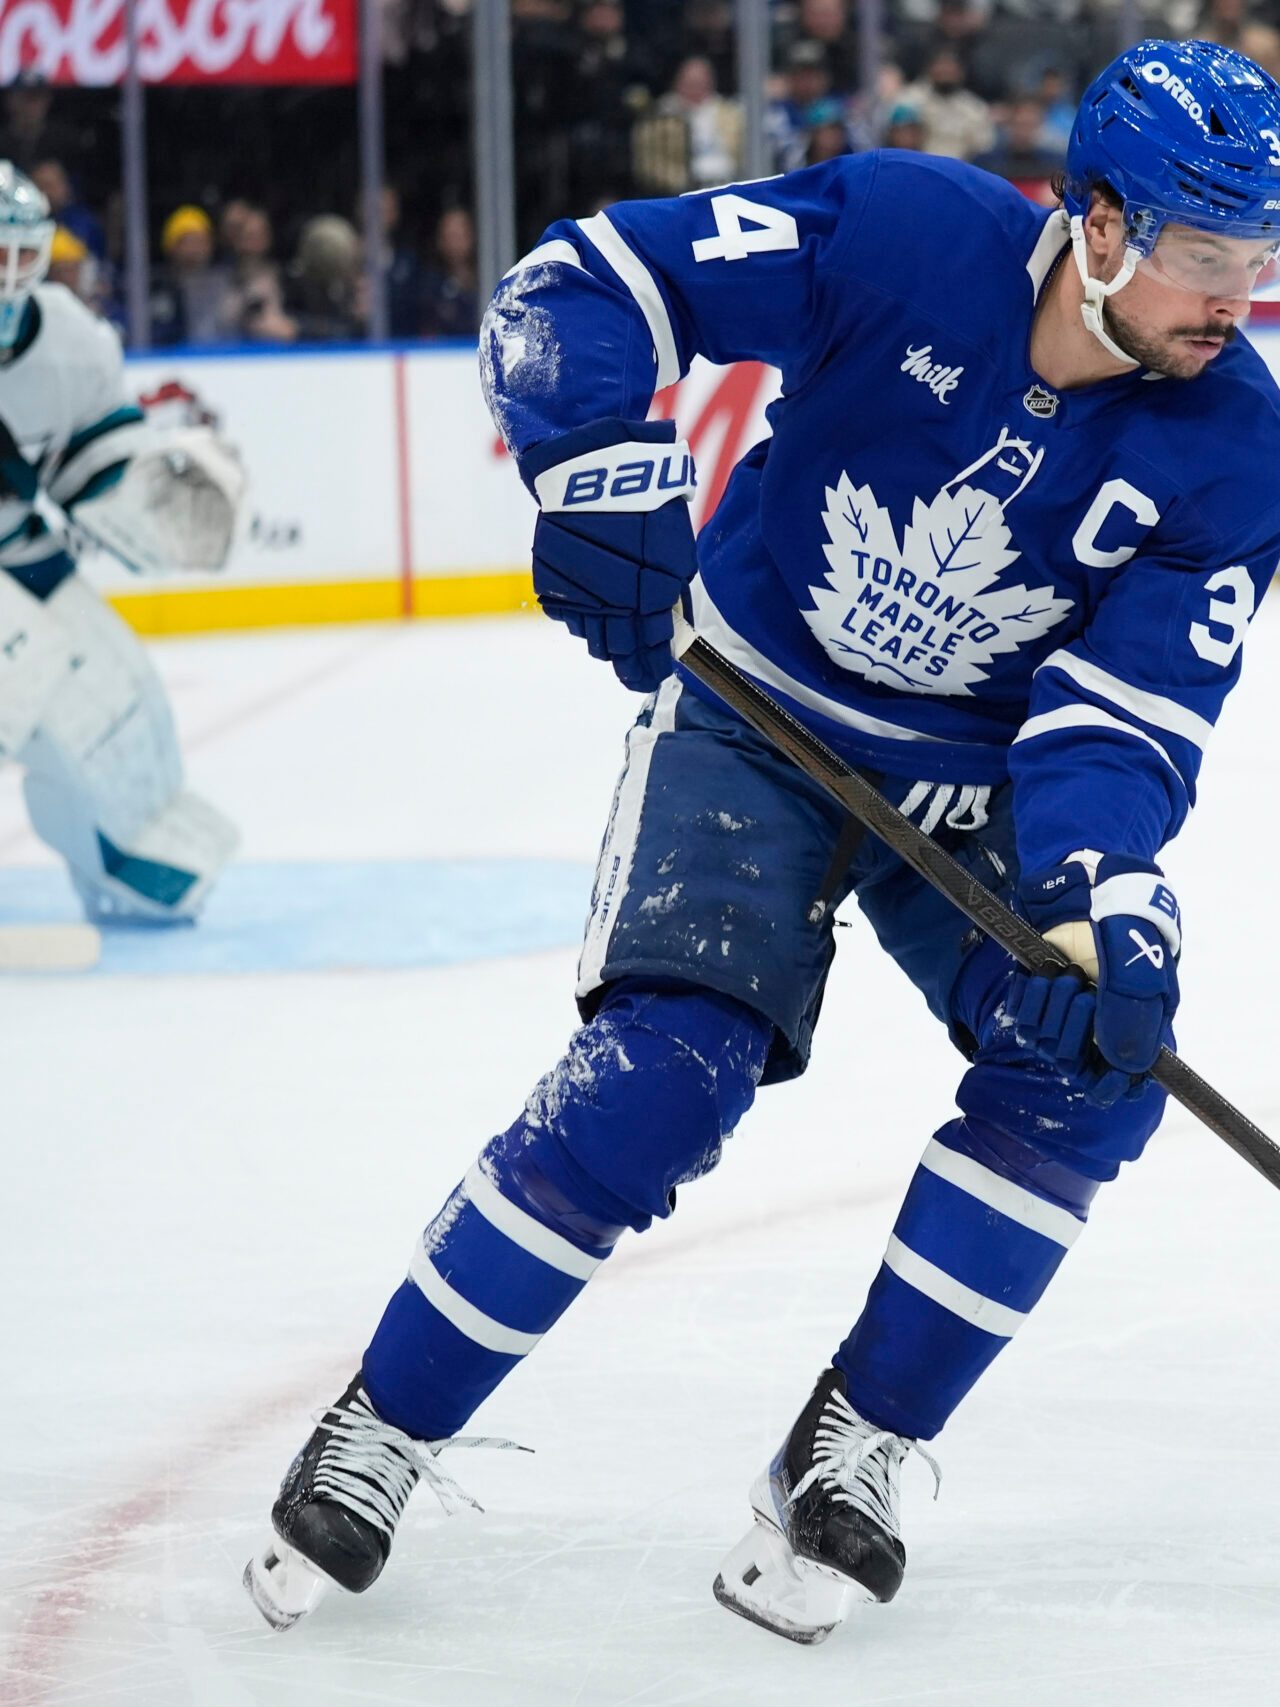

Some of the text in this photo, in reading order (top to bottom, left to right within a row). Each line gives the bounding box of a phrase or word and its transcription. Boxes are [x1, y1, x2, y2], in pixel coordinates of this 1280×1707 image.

[0, 0, 333, 87] olson
[1141, 61, 1203, 120] OREO
[679, 173, 799, 263] 4
[900, 344, 964, 405] Milk
[562, 454, 697, 506] BAU
[1072, 478, 1160, 568] C
[851, 550, 1000, 643] TORONTO
[857, 583, 965, 656] MAPLE
[841, 607, 948, 676] LEAFS
[600, 855, 621, 930] BAUE
[977, 906, 1044, 965] BAUE
